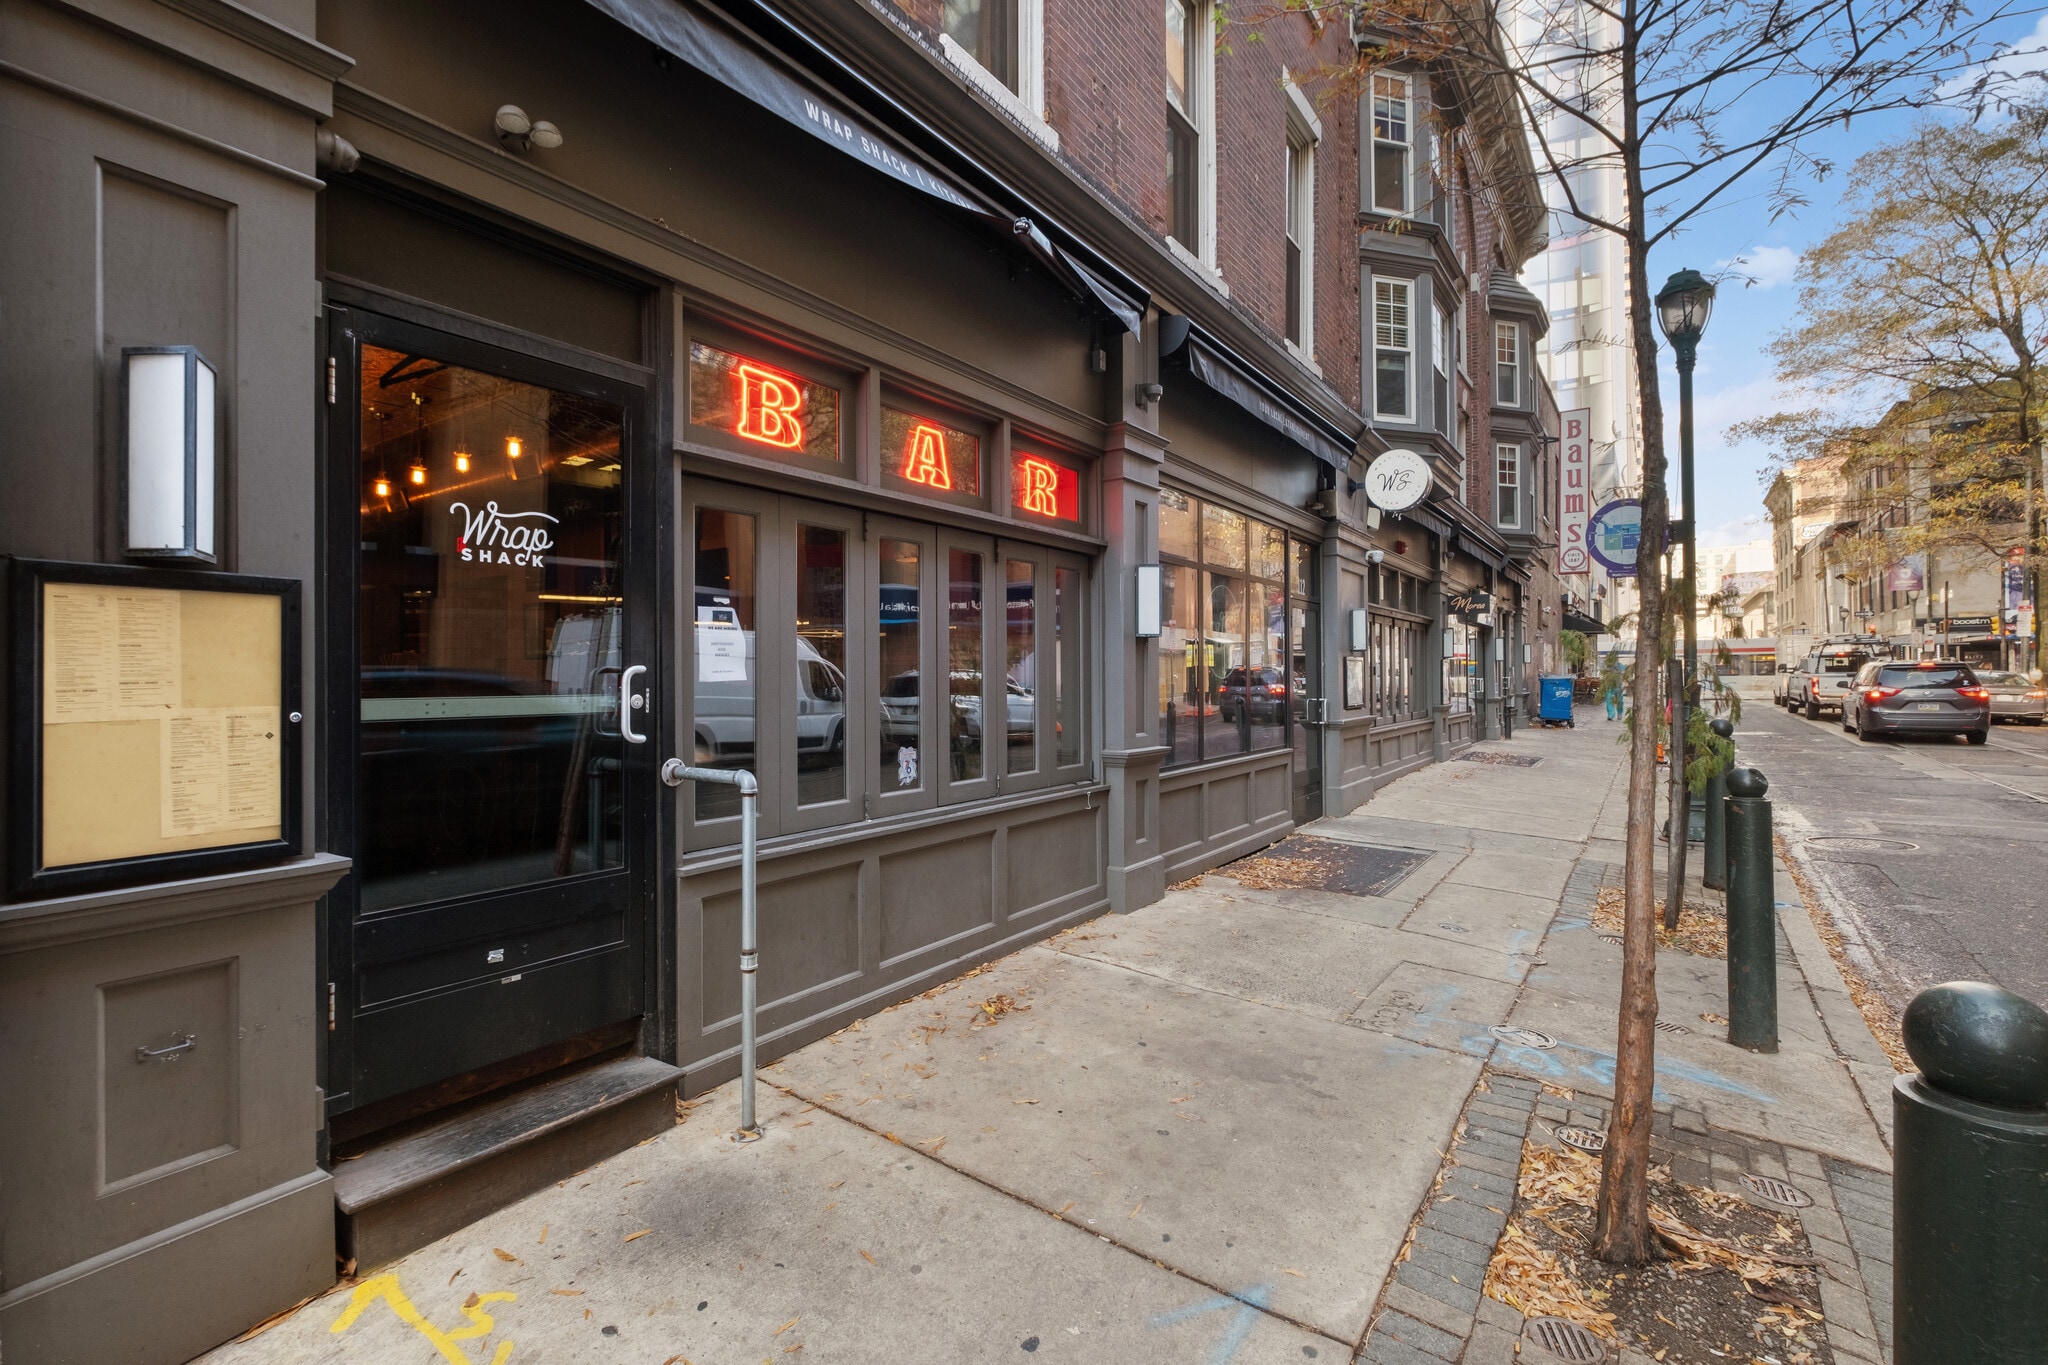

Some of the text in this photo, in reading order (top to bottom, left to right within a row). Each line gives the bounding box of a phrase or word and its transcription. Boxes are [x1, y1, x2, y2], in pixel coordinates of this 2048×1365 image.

[804, 99, 853, 142] WRAP
[861, 136, 911, 178] SHACK
[449, 501, 560, 562] Wrap
[461, 548, 544, 568] SHACK
